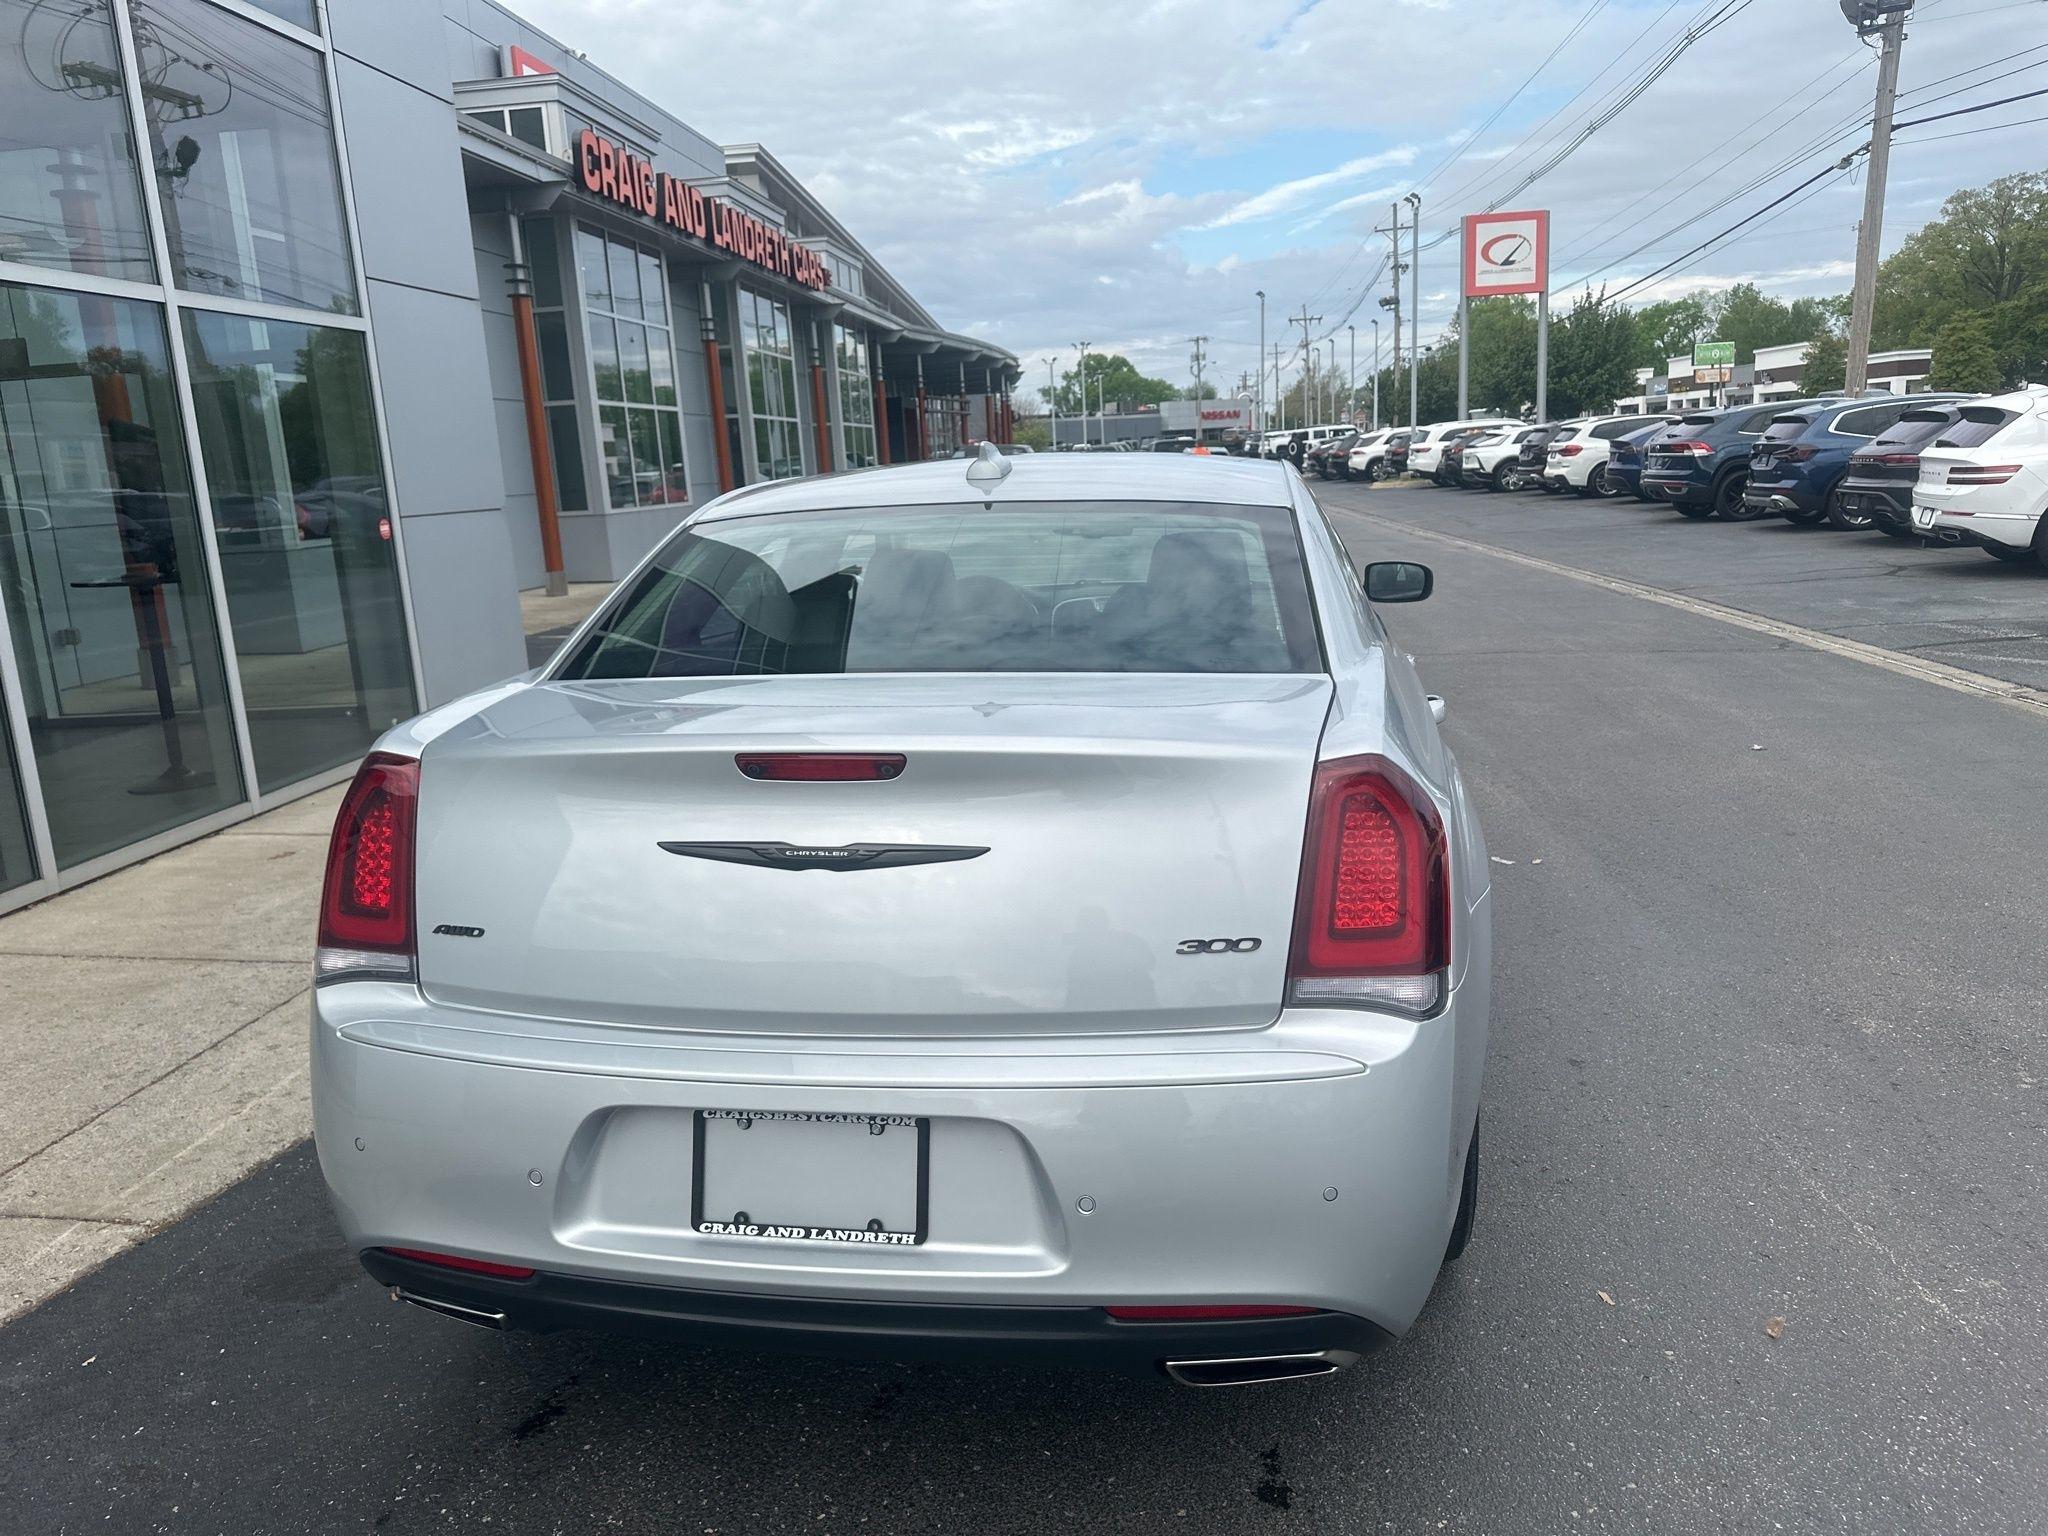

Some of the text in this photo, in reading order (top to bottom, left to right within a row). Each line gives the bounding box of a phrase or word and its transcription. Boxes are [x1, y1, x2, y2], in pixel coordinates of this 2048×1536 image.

[578, 128, 826, 292] CRAIG AND LANDRETH CARS
[1201, 410, 1241, 420] NISSAN
[432, 924, 485, 938] AWD
[1175, 937, 1263, 955] 300
[702, 1110, 917, 1127] CRAIGSBESTCARS.COM
[698, 1222, 917, 1245] CRAIG AND LANDRETH
